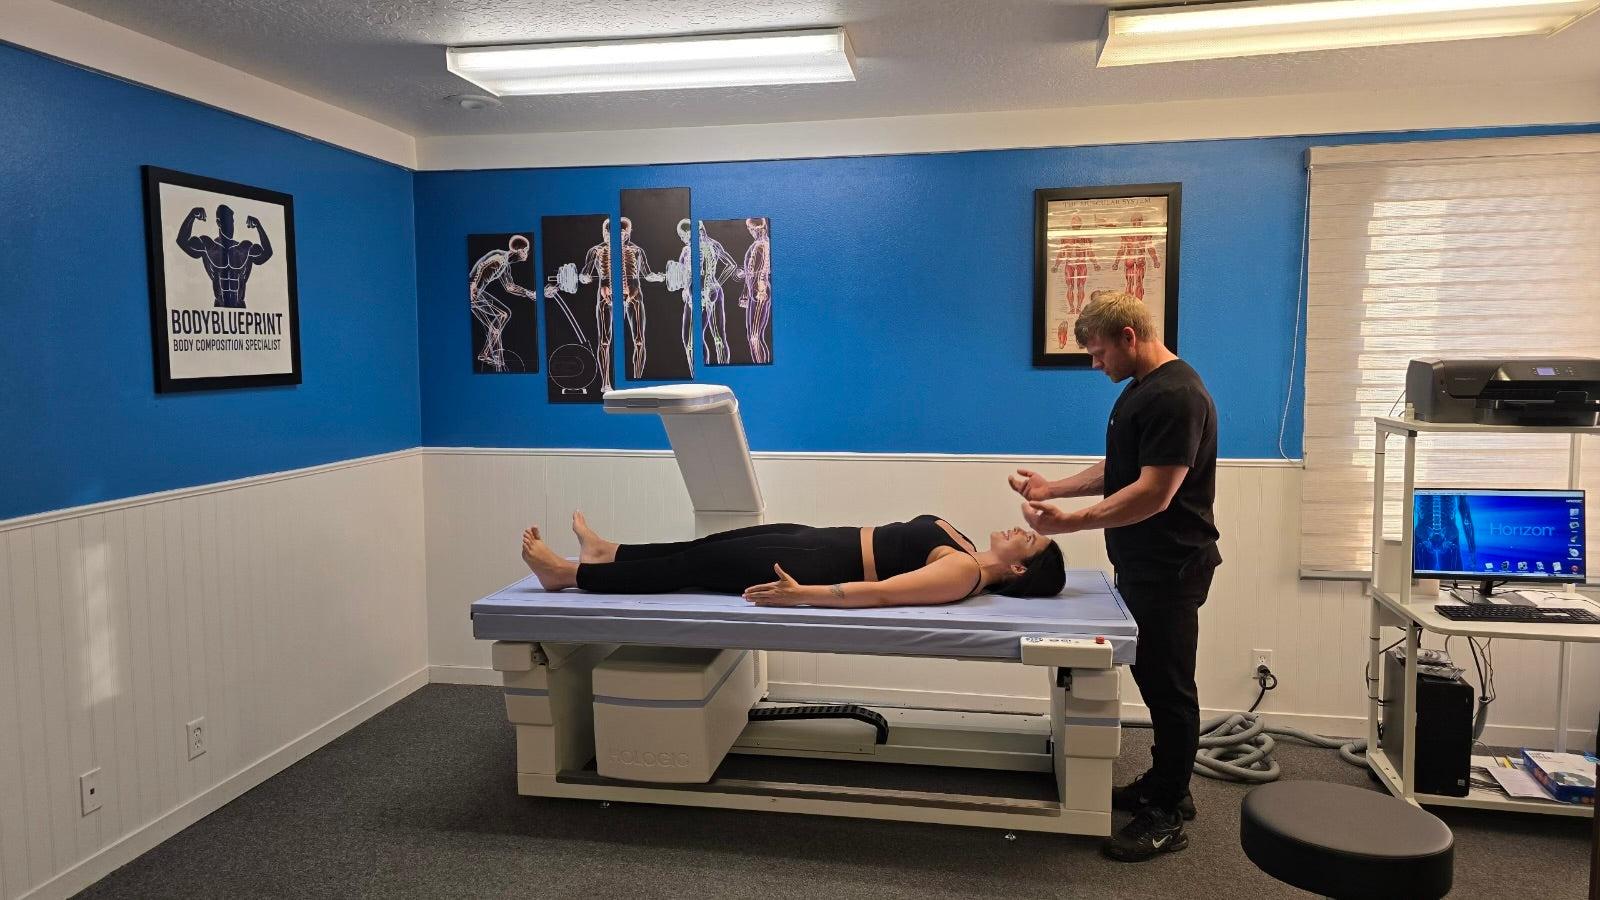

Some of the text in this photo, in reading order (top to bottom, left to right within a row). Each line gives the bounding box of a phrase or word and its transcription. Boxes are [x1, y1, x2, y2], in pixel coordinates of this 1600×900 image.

[171, 309, 283, 335] BODYBLUEPRINT
[173, 338, 281, 352] BODY COMPOSITION SPECIALIST
[1490, 522, 1553, 537] Horizon
[608, 750, 690, 768] HOLOGIC
